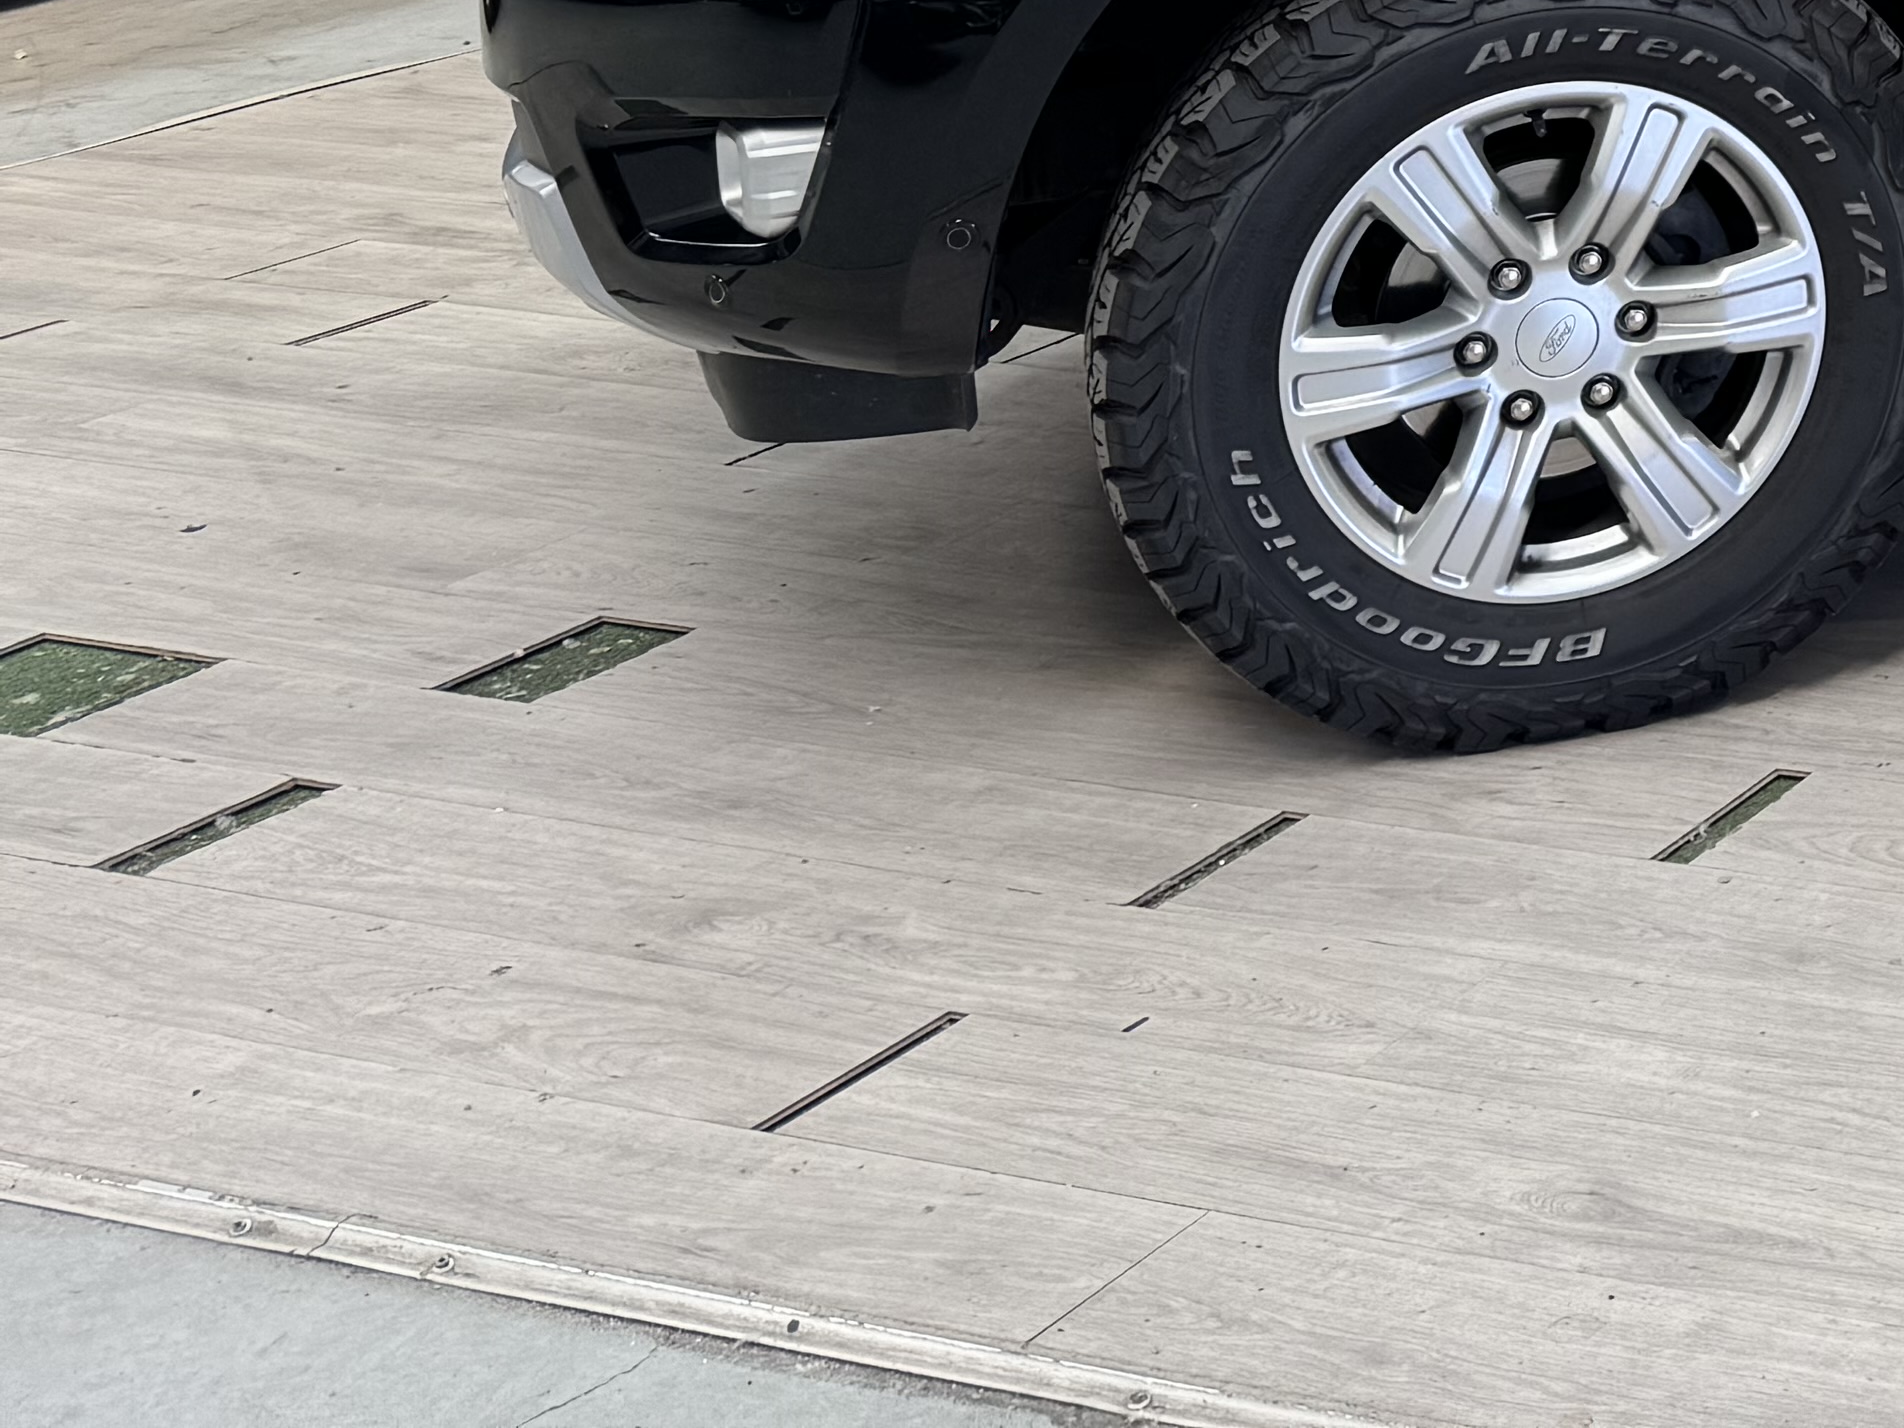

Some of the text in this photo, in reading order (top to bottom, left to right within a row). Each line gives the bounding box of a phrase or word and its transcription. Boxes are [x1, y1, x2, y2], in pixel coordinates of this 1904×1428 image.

[1464, 26, 1888, 299] All-Terrain T/A
[1228, 447, 1609, 669] BFGoodrich
